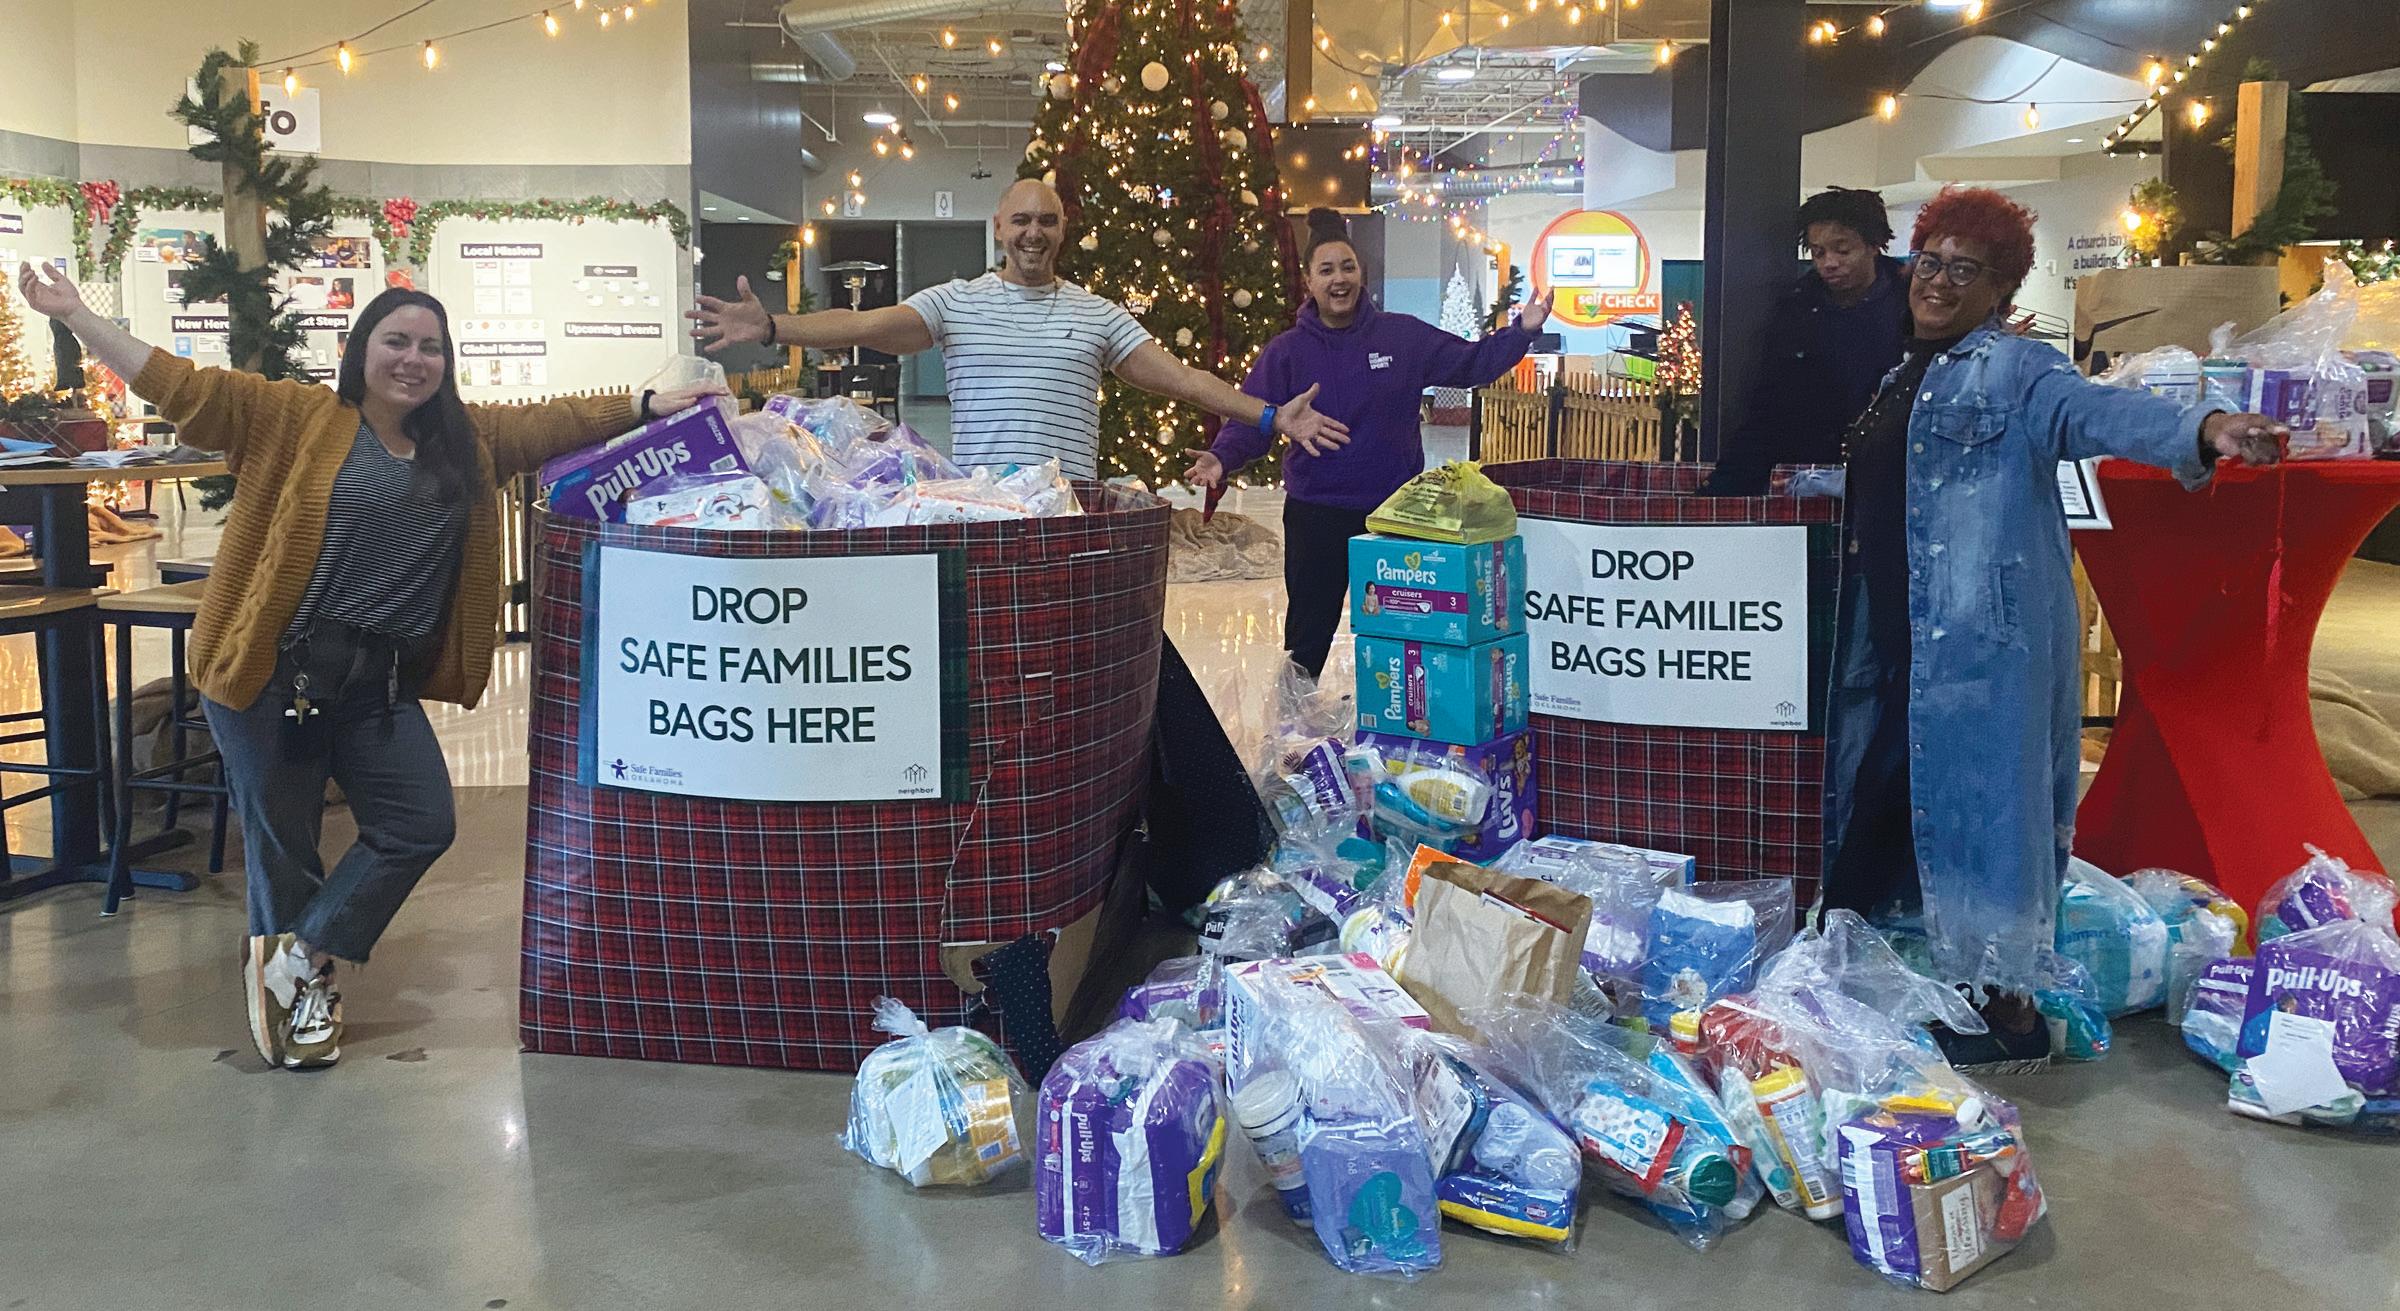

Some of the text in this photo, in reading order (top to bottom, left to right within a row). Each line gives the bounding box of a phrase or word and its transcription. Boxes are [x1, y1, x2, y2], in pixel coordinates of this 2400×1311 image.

[2067, 237, 2075, 250] A
[2076, 234, 2107, 250] church
[463, 245, 540, 257] Local Missions
[2073, 253, 2120, 270] a building.
[2064, 276, 2077, 290] It's
[1578, 291, 1656, 308] self CHECK
[174, 318, 203, 329] New
[316, 316, 347, 328] Steps
[566, 324, 660, 336] Upcoming Events
[461, 344, 545, 355] Global Missions
[585, 441, 691, 522] Pull-Ups
[1376, 558, 1437, 586] Pampers
[1591, 548, 1695, 581] DROP
[1391, 589, 1423, 599] cruisers
[1481, 559, 1493, 626] Pampers
[692, 585, 808, 625] DROP
[1449, 596, 1457, 607] 3
[1524, 590, 1783, 634] SAFE FAMILIES
[619, 636, 912, 685] SAFE FAMILIES
[1551, 640, 1752, 682] BAGS HERE
[1384, 656, 1404, 721] Pampers
[1505, 652, 1517, 718] Pampers
[1551, 695, 1581, 706] Families
[648, 699, 876, 744] BAGS HERE
[630, 764, 683, 778] Safe Families
[630, 775, 684, 786] OKLAHOMA
[897, 787, 934, 795] neighbor
[2210, 964, 2255, 978] Pull-Ups
[2265, 966, 2363, 1000] Pull-Ups
[1071, 1111, 1094, 1164] Pull-Ups
[1347, 1156, 1357, 1175] 168
